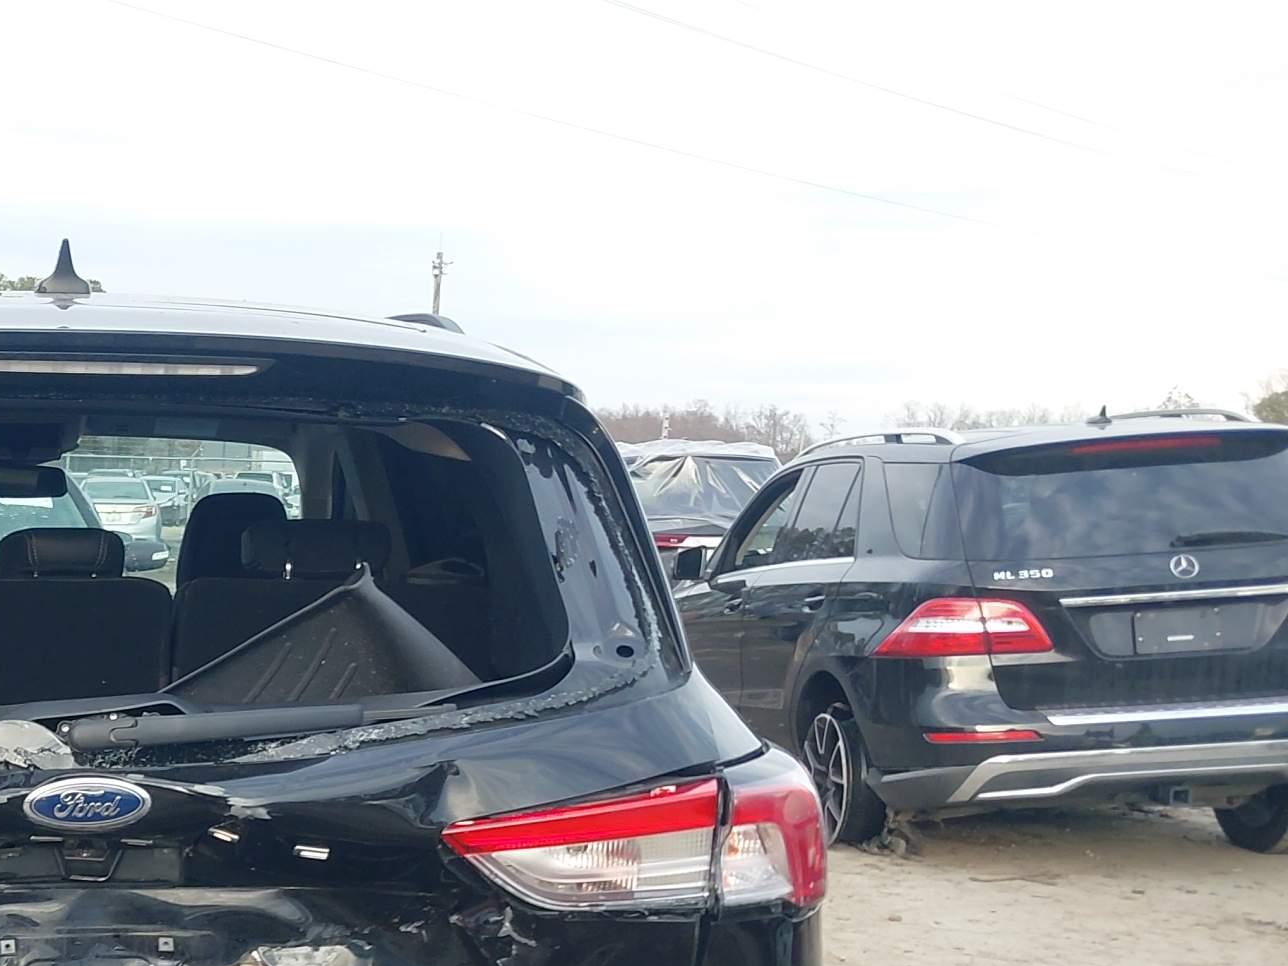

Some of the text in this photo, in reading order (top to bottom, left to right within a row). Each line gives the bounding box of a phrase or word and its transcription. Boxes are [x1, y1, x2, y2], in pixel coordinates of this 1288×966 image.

[993, 569, 1054, 580] ML 350
[53, 789, 121, 815] Ford
